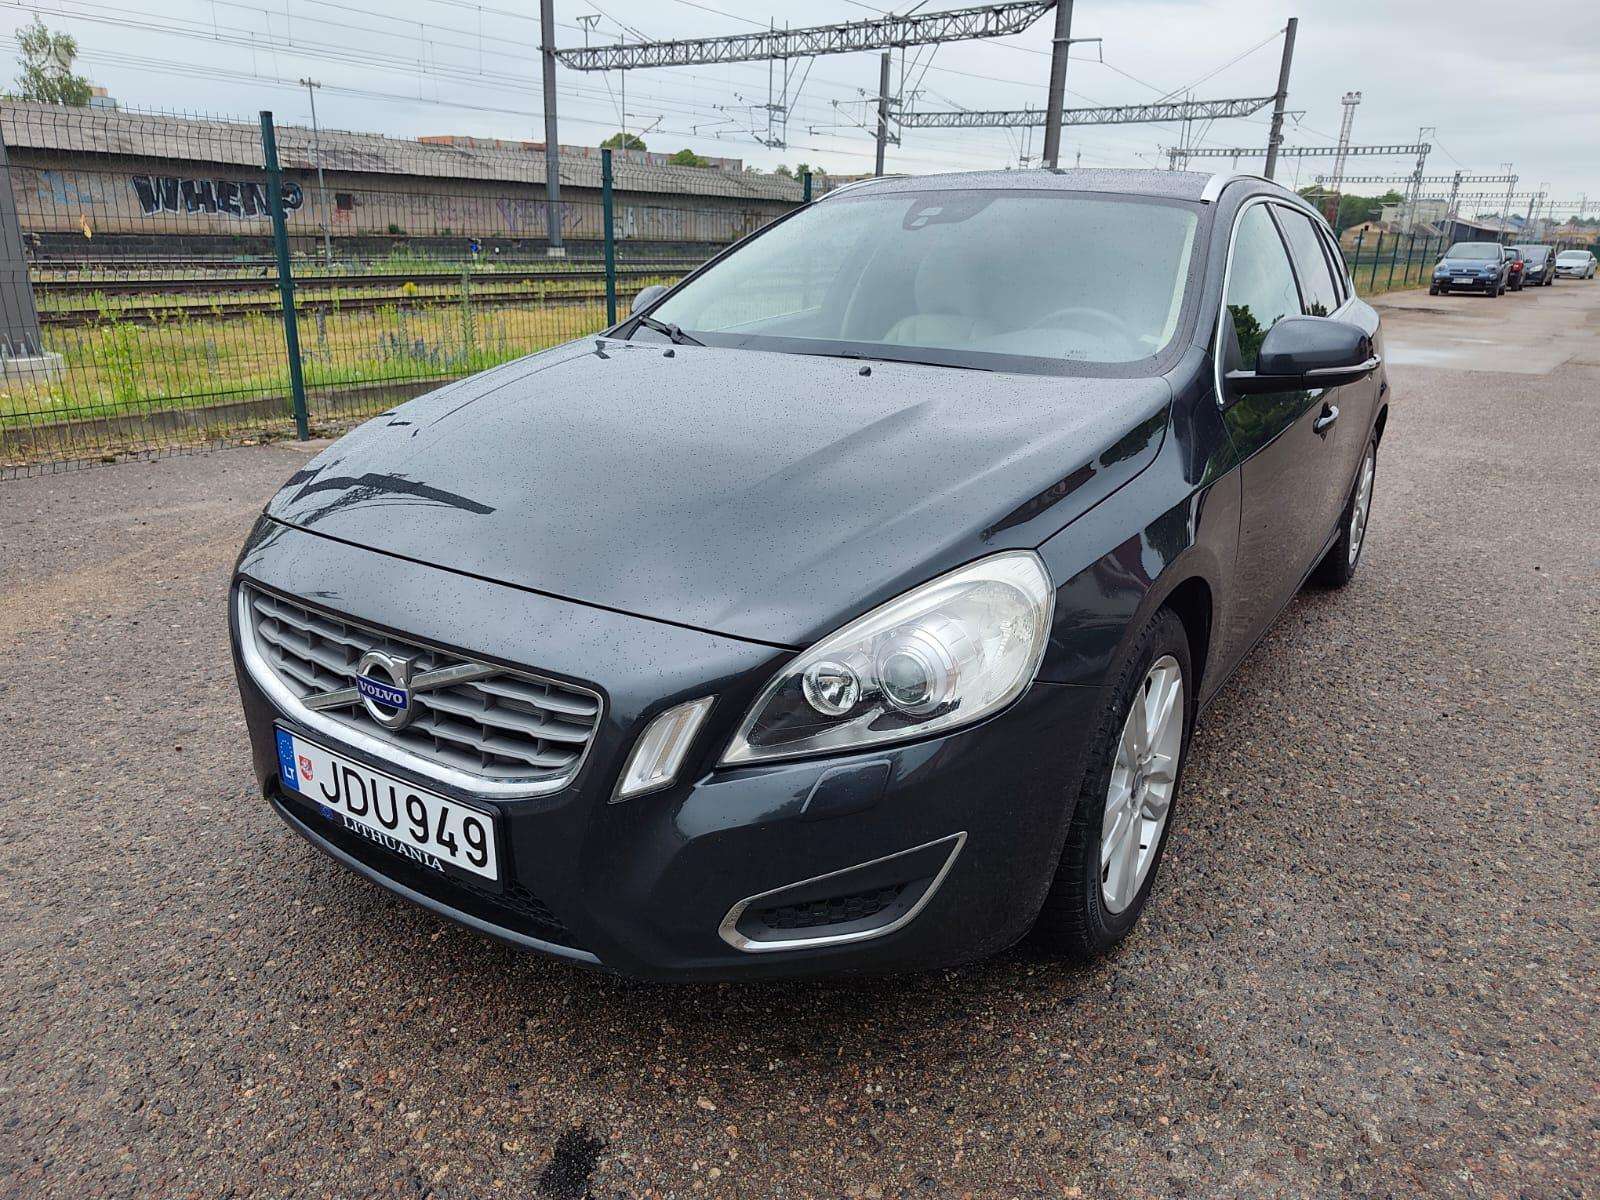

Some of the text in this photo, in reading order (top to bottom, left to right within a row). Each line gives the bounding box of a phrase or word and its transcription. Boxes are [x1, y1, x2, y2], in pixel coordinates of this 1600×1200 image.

[359, 680, 403, 704] VOLVO
[284, 765, 295, 780] LT
[320, 761, 488, 867] JDU949
[342, 814, 446, 873] LITHUANIA
